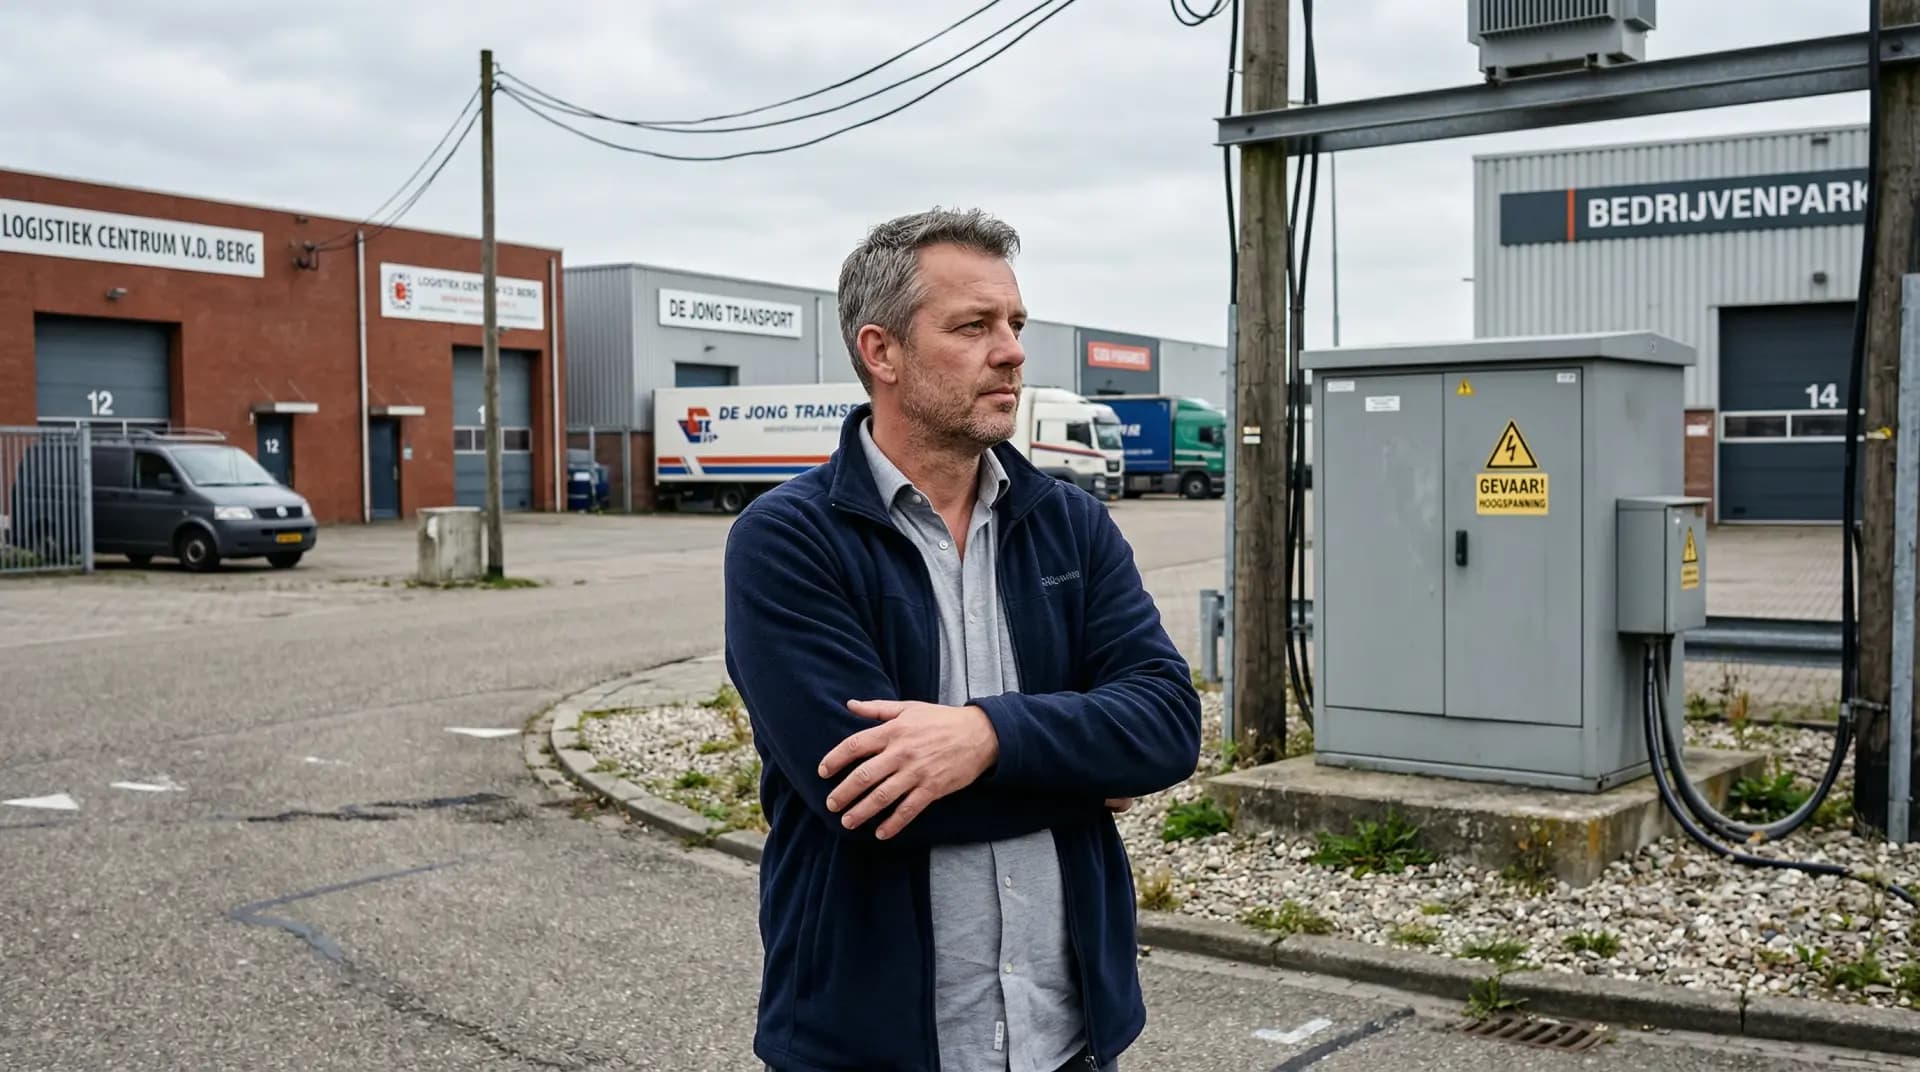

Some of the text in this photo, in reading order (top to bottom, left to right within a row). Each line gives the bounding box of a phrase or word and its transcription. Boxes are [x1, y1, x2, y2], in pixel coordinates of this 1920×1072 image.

[1588, 180, 1868, 228] BEDRIJVENPARK
[2, 213, 255, 265] LOGISTIEK CENTRUM V.D. BERG
[669, 299, 794, 329] DE JONG TRANSPORT
[87, 390, 114, 416] 12
[1805, 383, 1839, 409] 14
[719, 406, 739, 420] DE
[745, 405, 788, 419] JONG
[265, 438, 280, 454] 12
[1480, 478, 1545, 494] GEVAAR!
[1479, 498, 1546, 509] HOOGSPANNING
